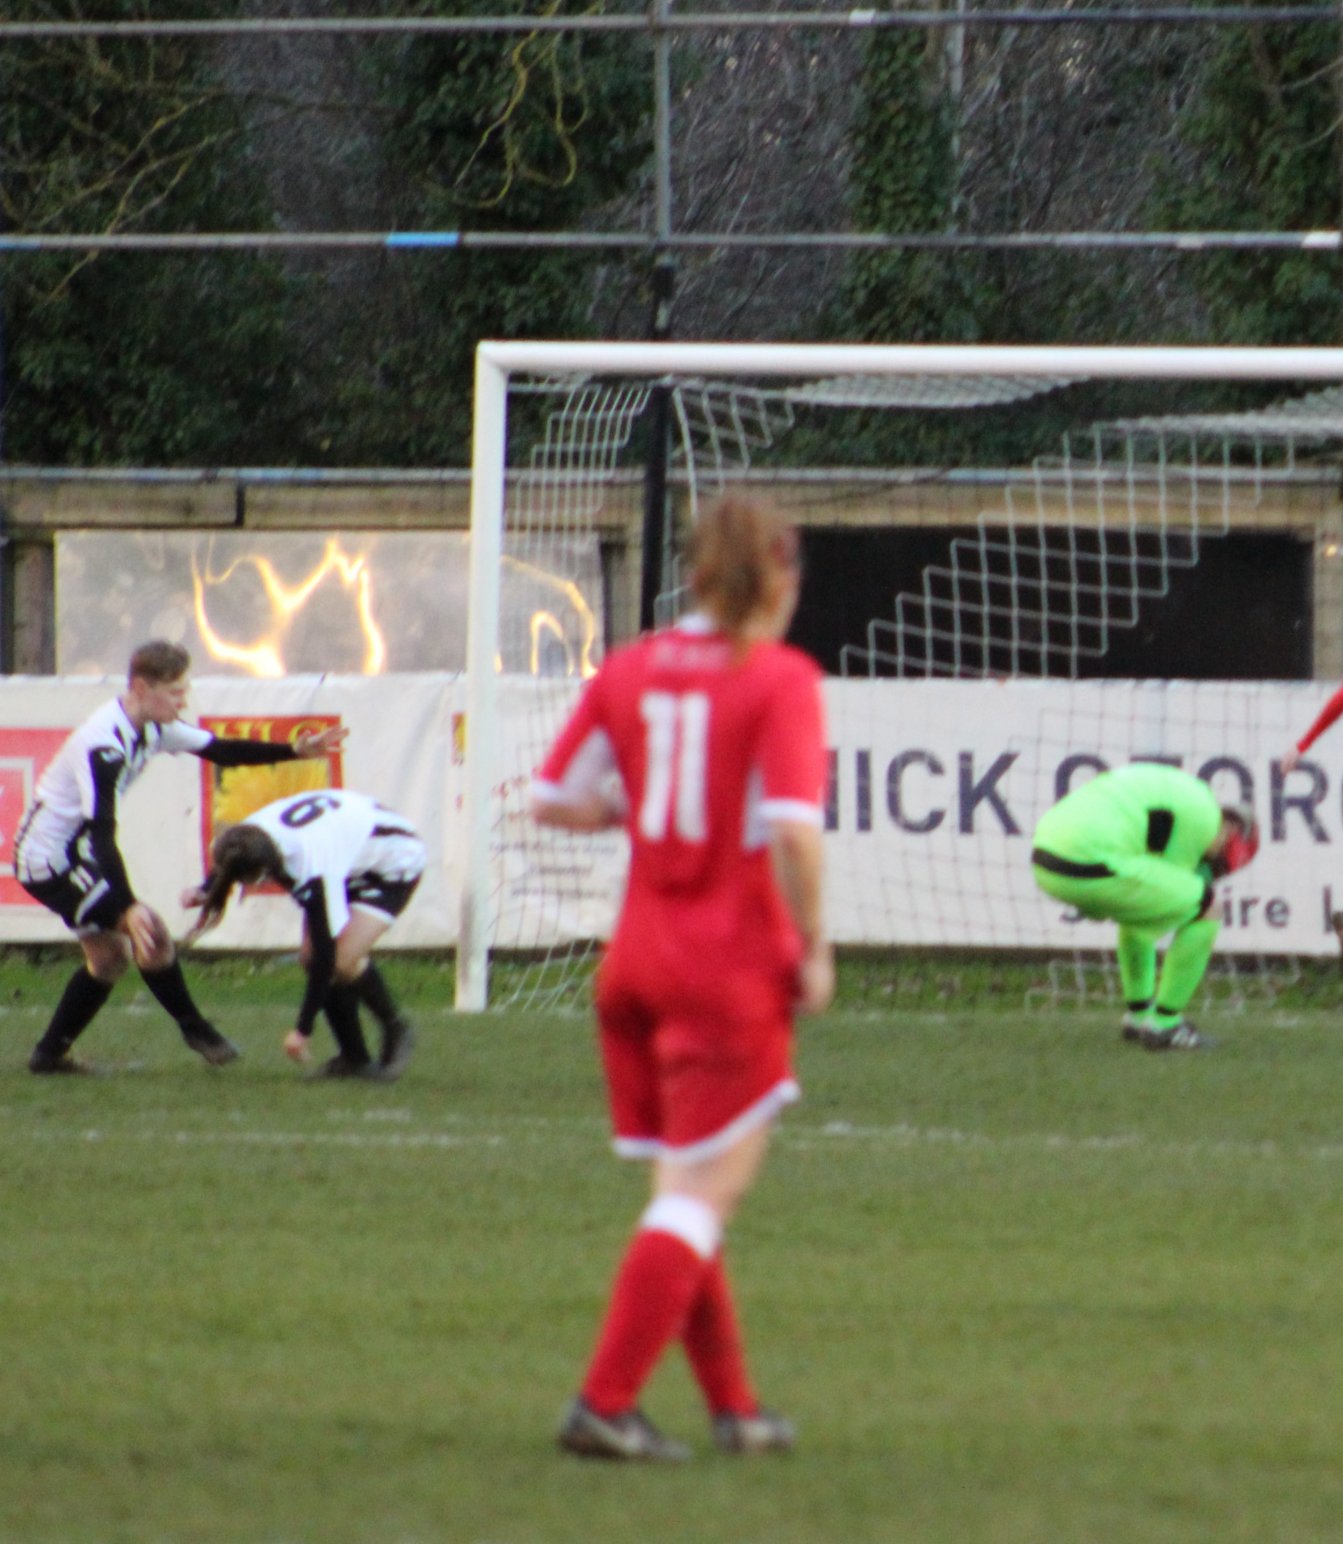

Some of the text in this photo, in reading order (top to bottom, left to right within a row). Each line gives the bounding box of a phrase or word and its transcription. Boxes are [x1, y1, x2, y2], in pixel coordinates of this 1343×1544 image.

[640, 691, 710, 842] 11
[824, 748, 1022, 835] ICK
[1223, 887, 1291, 928] ire
